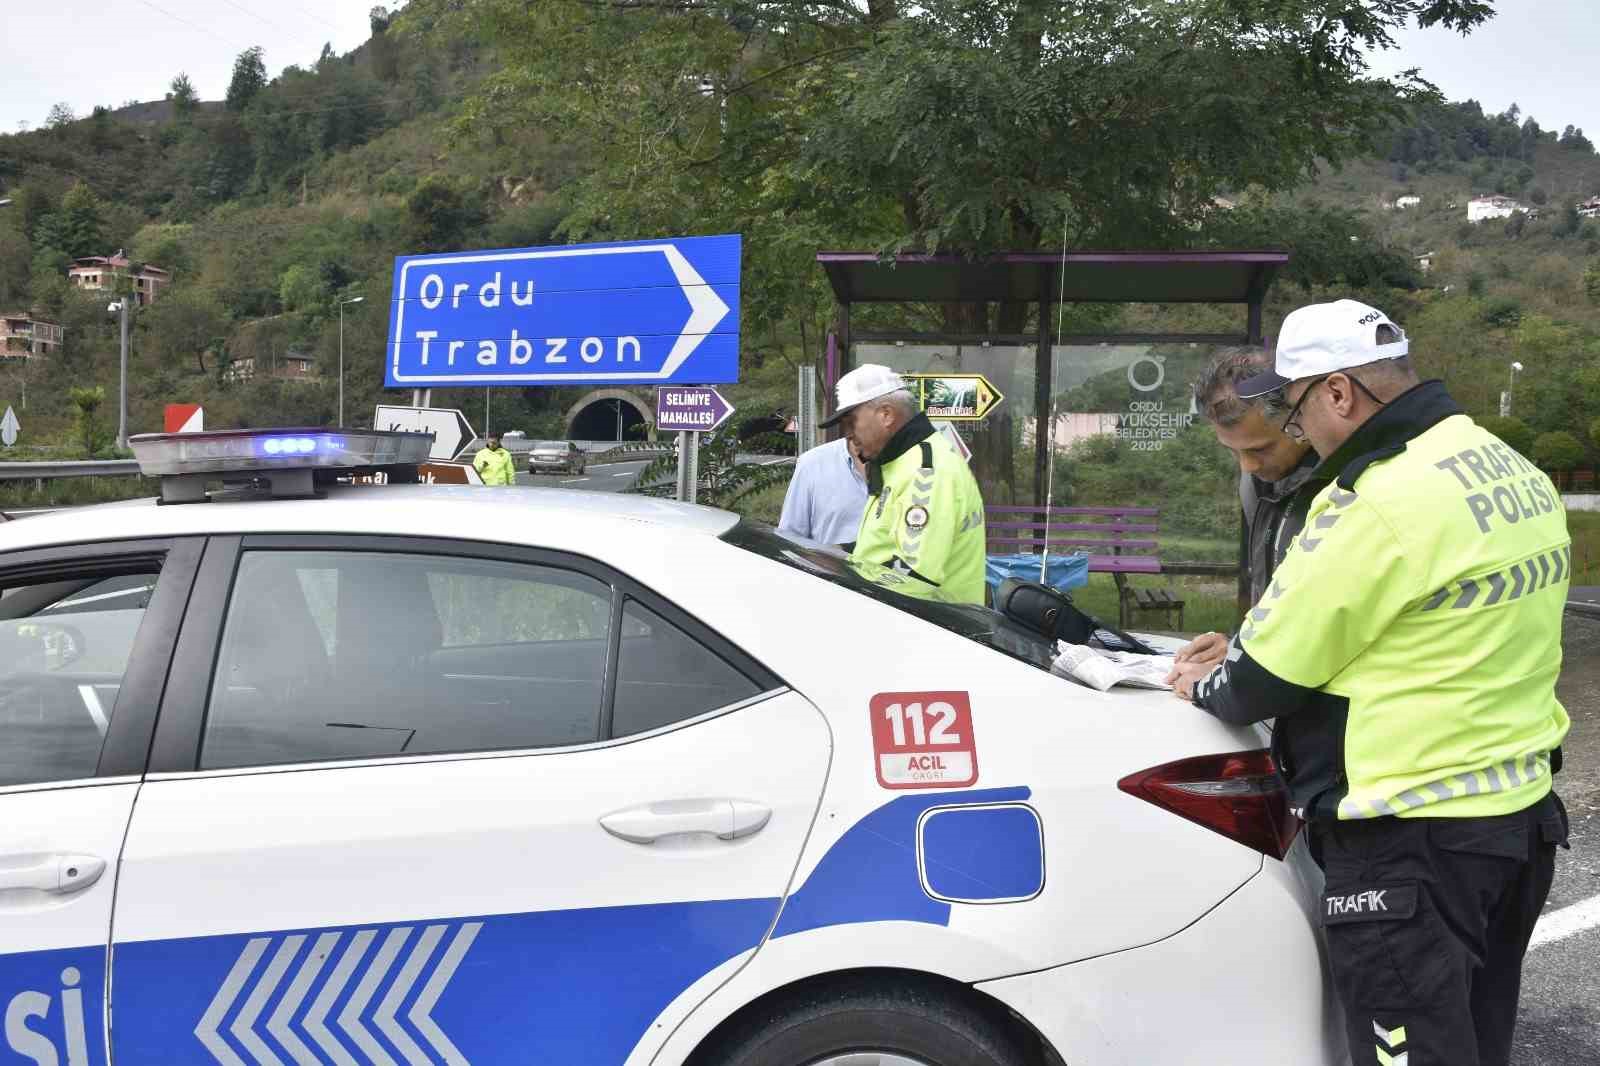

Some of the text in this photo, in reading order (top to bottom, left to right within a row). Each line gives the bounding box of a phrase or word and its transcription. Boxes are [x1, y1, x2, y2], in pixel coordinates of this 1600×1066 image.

[419, 272, 534, 309] Ordu
[416, 329, 641, 366] Trabzon
[666, 390, 711, 406] SELİMİYE
[1129, 401, 1163, 412] ORDU
[660, 409, 715, 425] MAHALLESİ
[1131, 440, 1163, 451] 2020
[885, 701, 961, 746] 112
[908, 755, 947, 770] ACİL
[1326, 890, 1388, 915] TRAFİK
